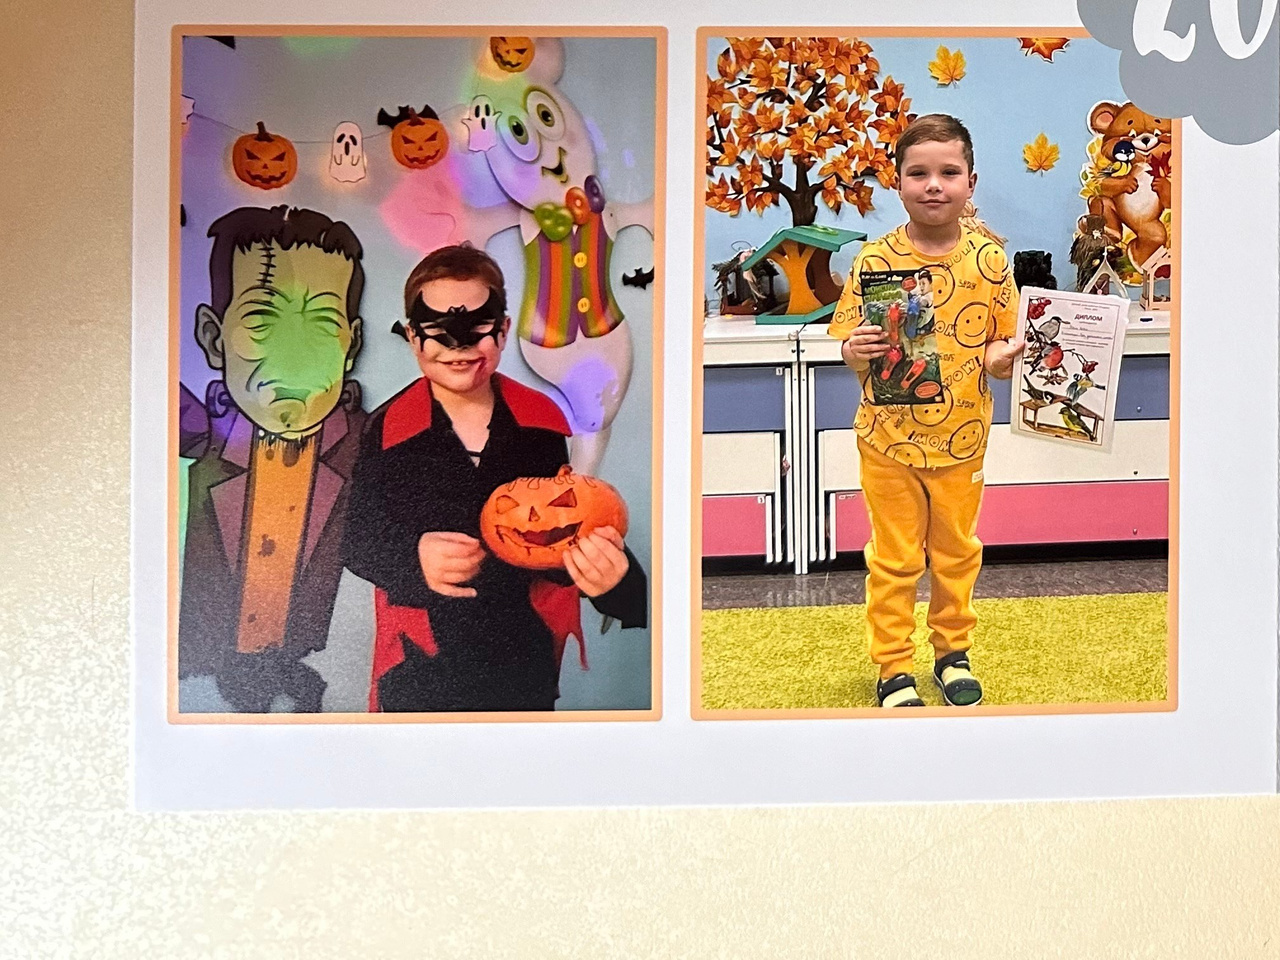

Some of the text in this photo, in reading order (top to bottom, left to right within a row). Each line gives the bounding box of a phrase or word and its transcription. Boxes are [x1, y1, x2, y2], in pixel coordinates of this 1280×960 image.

[835, 305, 863, 324] OW!
[1074, 313, 1103, 321] ДИПЛОМ
[943, 356, 981, 387] WOW!
